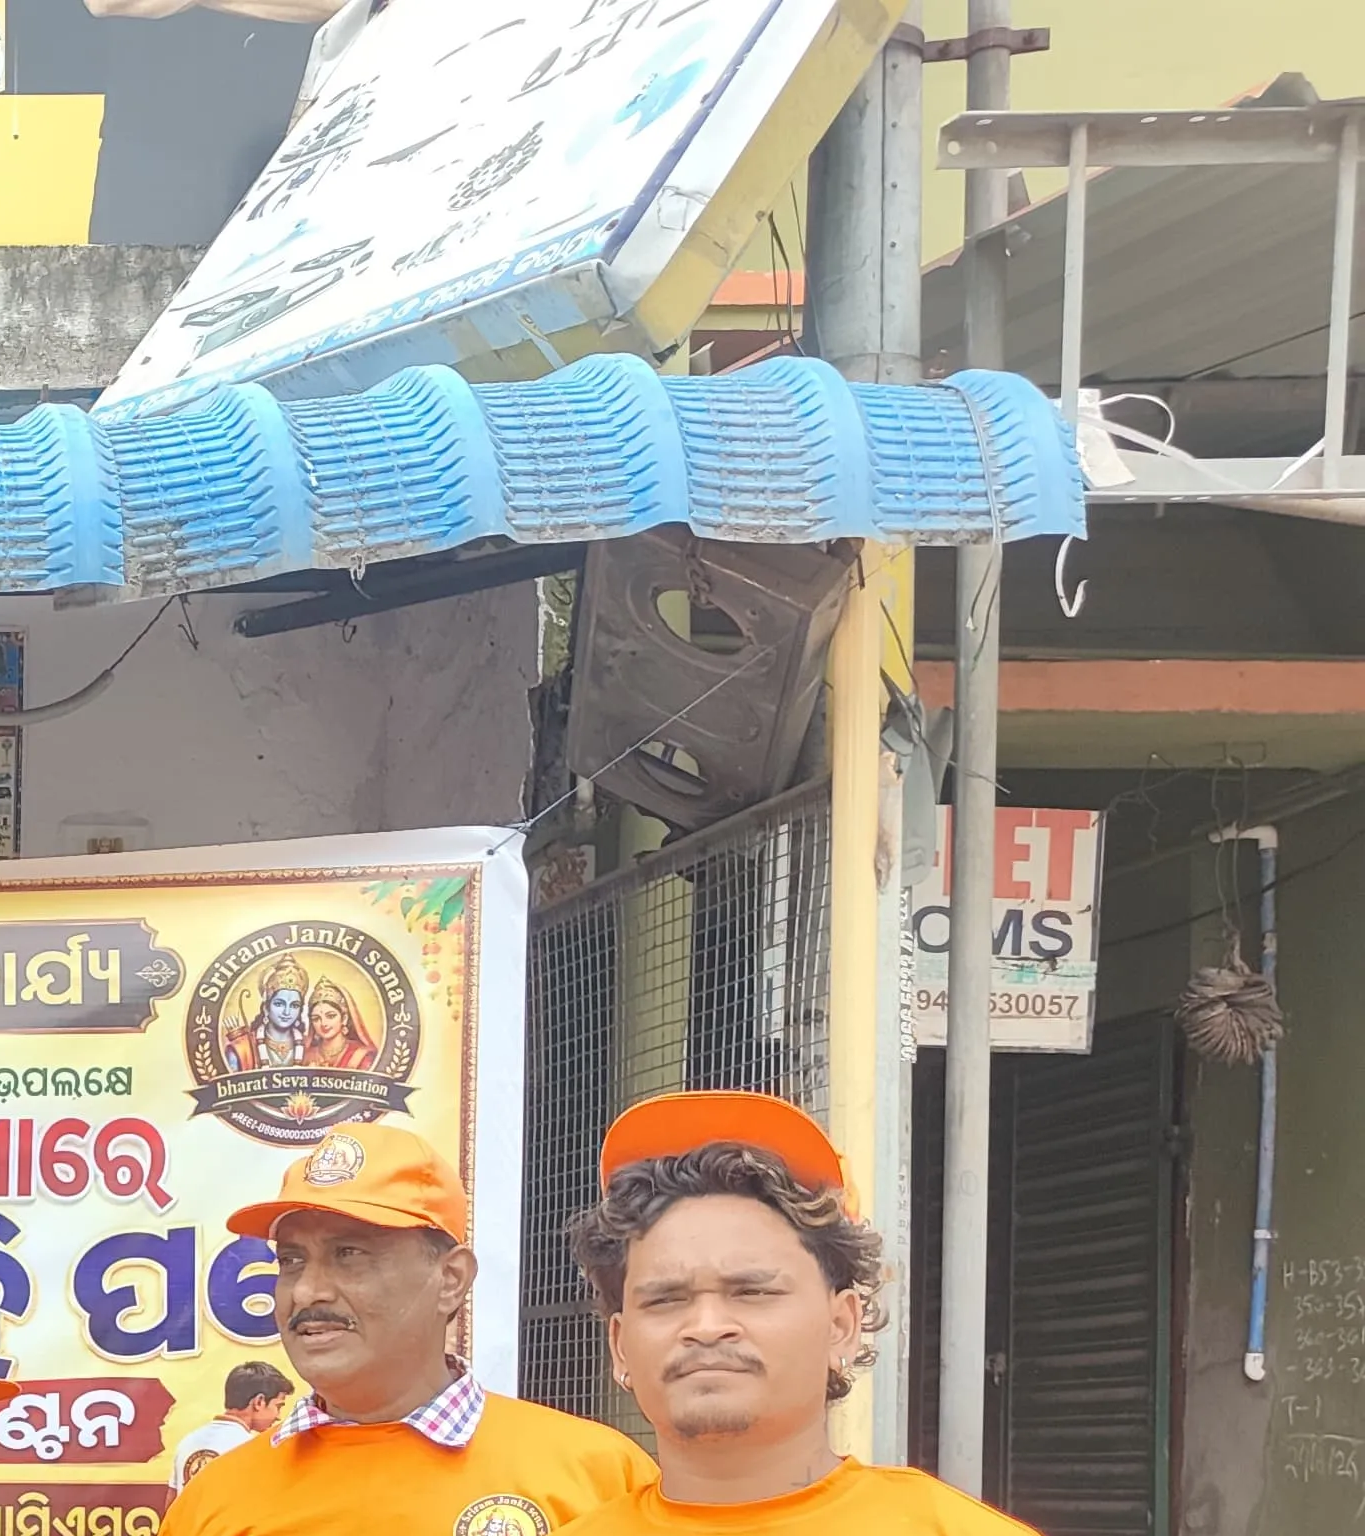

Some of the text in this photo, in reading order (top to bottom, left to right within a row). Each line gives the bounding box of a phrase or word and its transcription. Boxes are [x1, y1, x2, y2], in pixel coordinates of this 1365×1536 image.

[198, 924, 406, 1005] Sriram Janki sena
[217, 1073, 389, 1099] bharat Seva association
